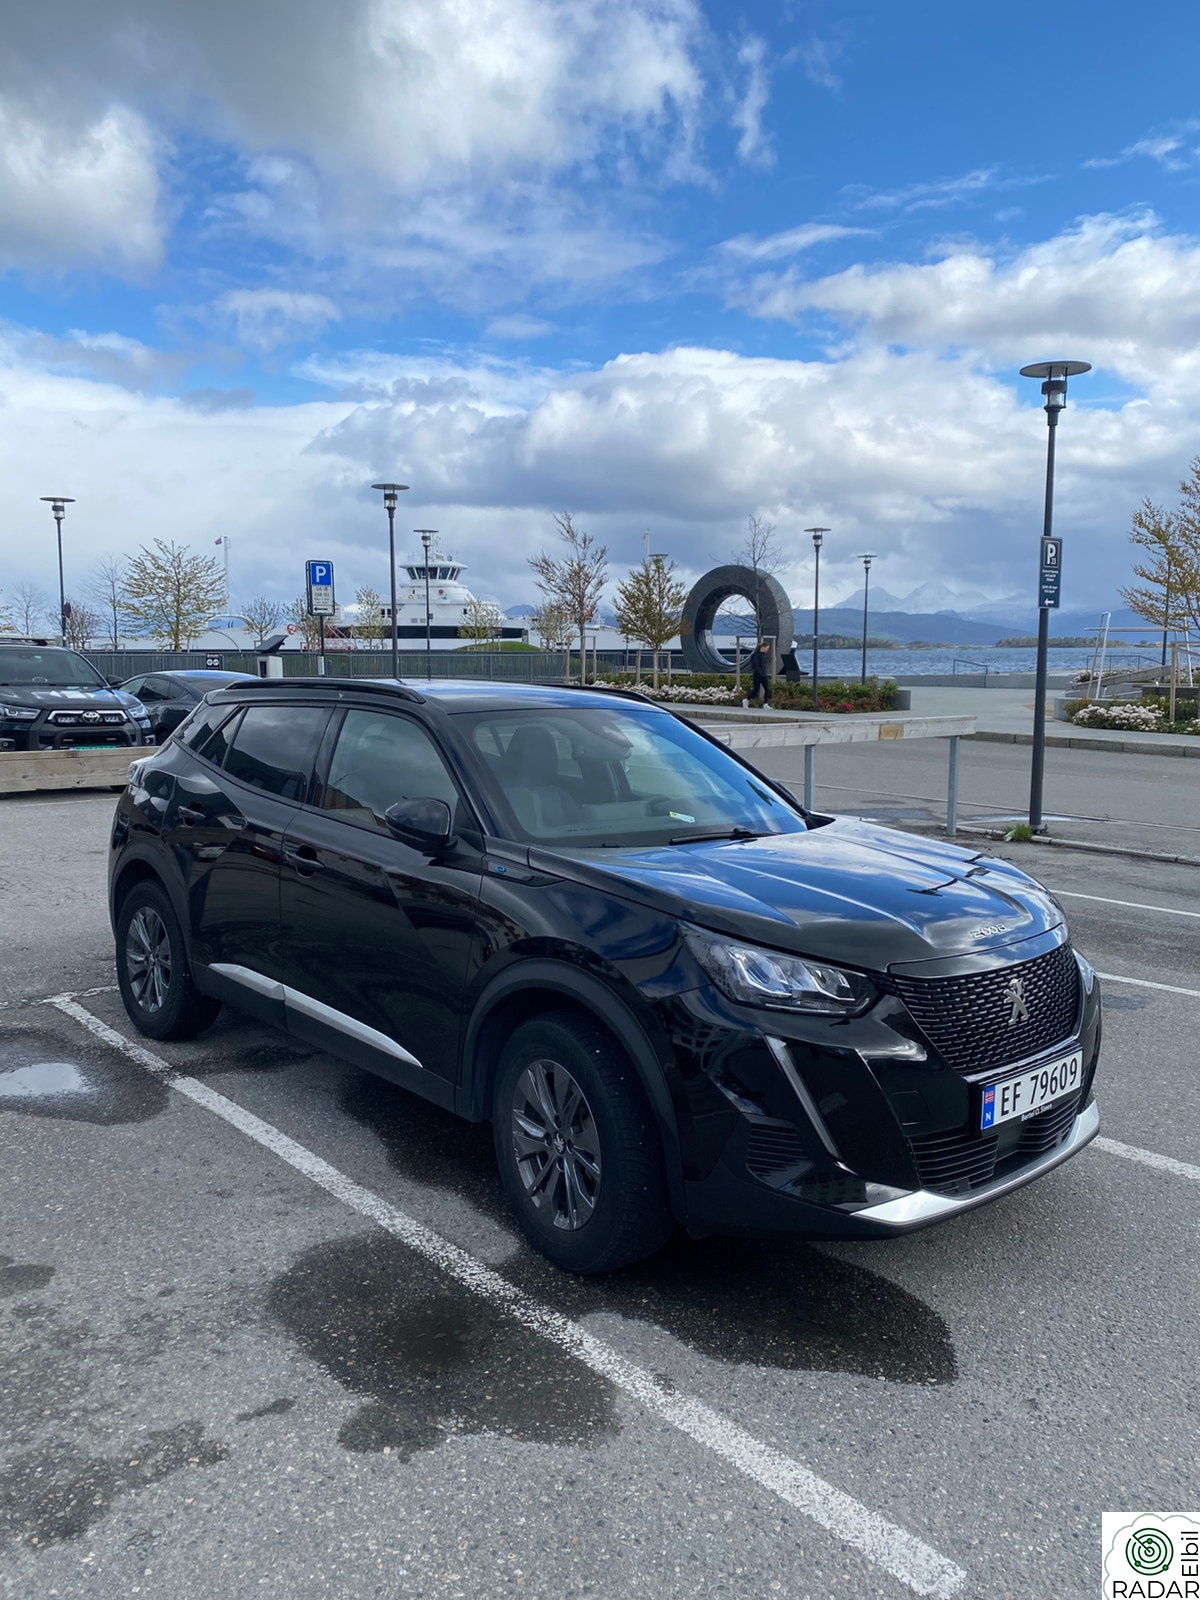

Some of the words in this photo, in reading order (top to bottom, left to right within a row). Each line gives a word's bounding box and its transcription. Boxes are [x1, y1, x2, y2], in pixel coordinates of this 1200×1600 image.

[1046, 543, 1056, 565] P
[315, 565, 327, 583] P
[969, 923, 1007, 938] 2008
[1001, 1080, 1022, 1117] EF
[1030, 1057, 1078, 1105] 79609
[985, 1111, 992, 1122] N
